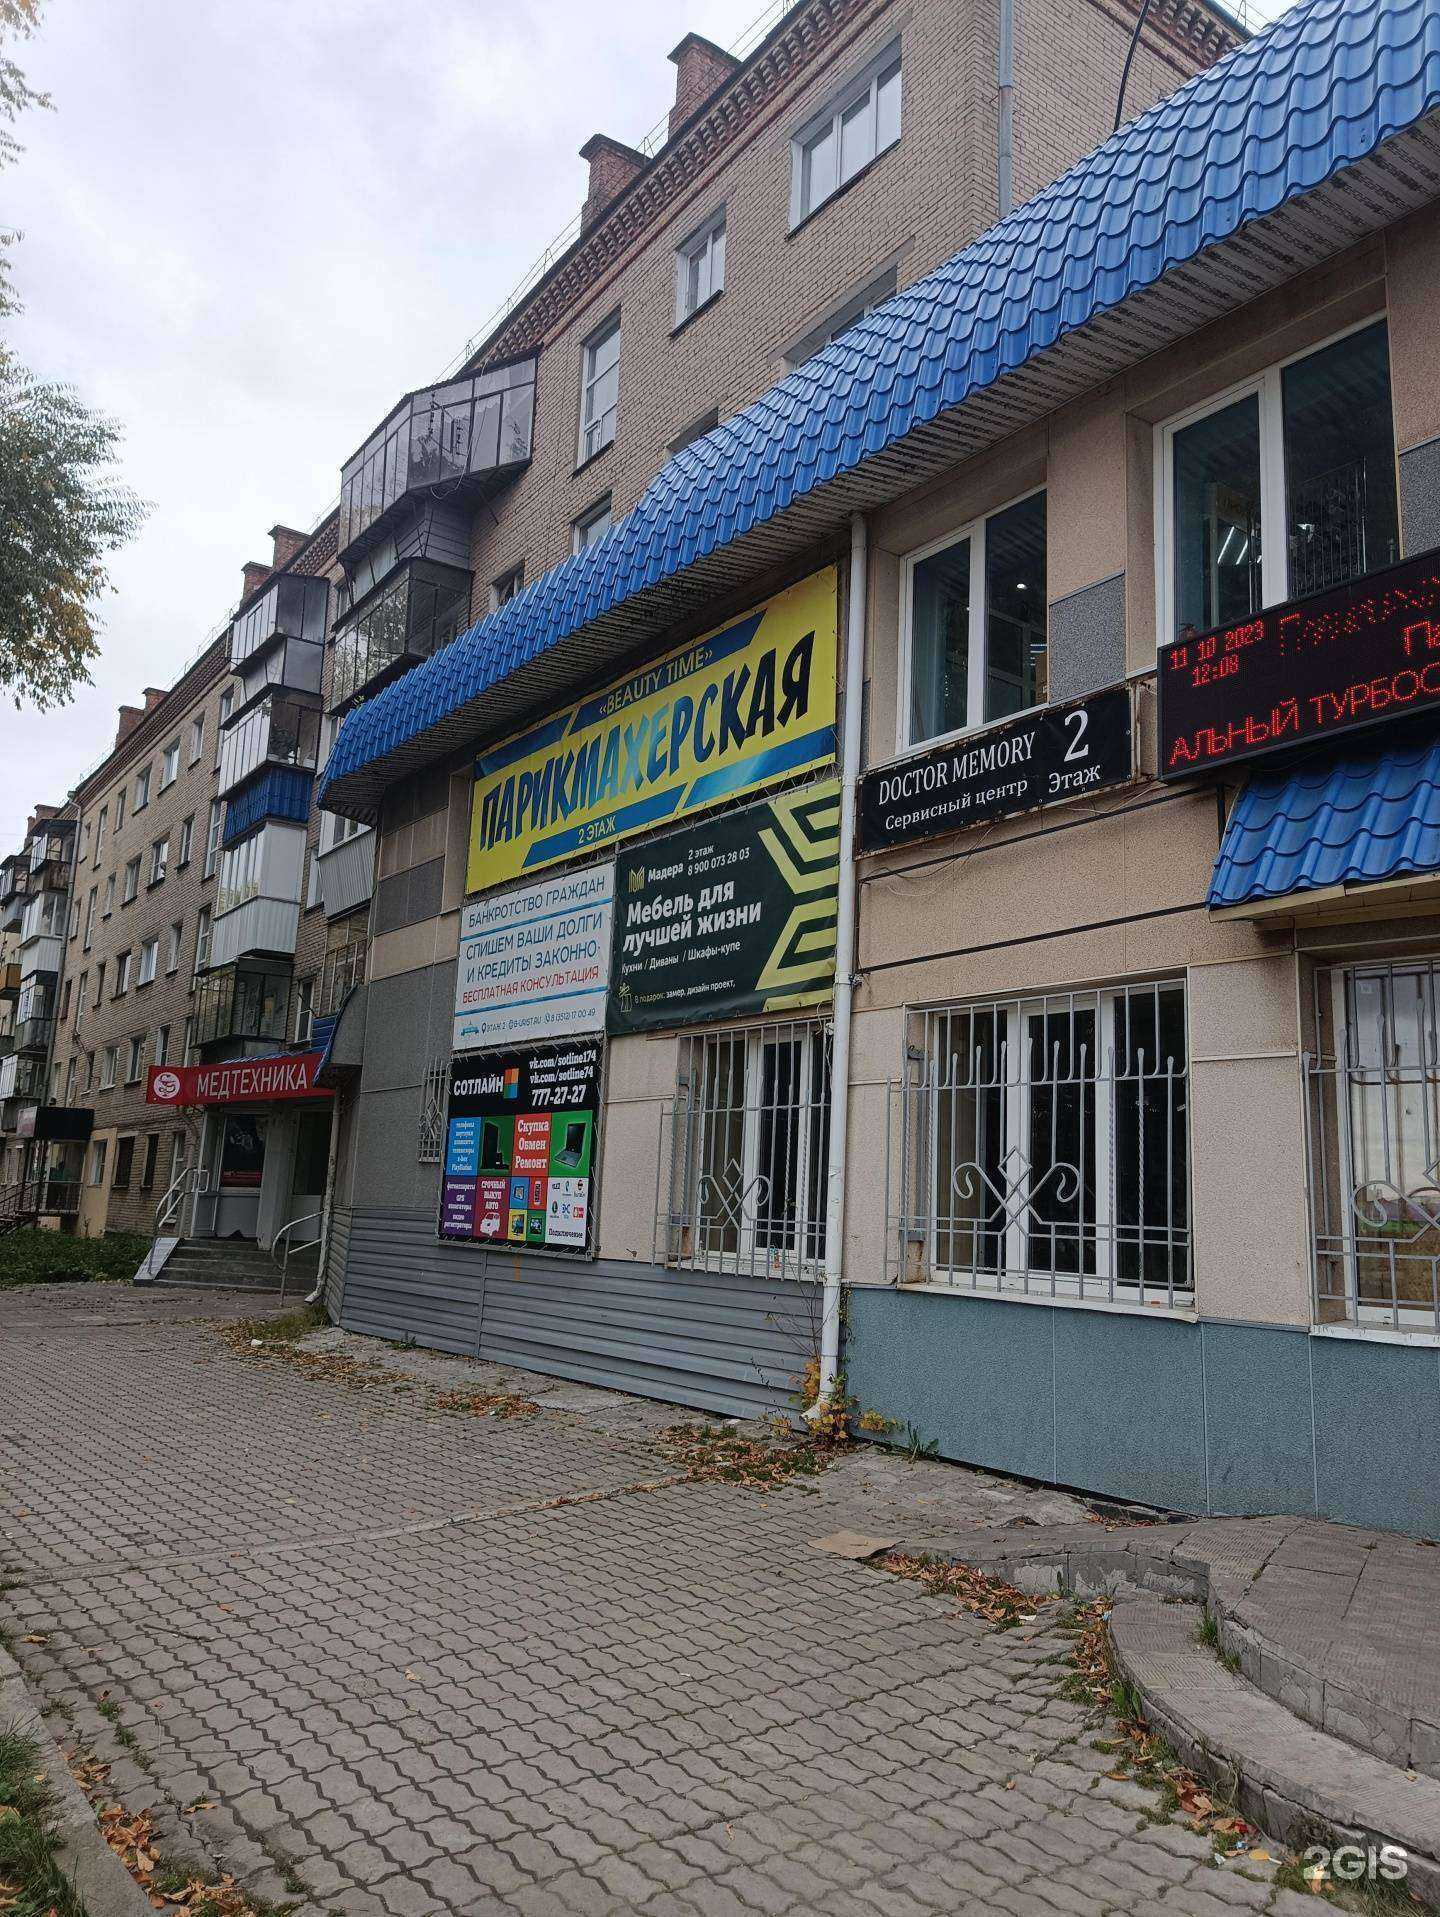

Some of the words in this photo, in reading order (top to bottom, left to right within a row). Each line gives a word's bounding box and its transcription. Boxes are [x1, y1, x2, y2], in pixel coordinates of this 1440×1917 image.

[600, 668, 662, 715] «BEAUTY
[666, 647, 713, 684] TIME»
[479, 630, 816, 852] ПАРИКМАХЕРСКАЯ
[1169, 697, 1300, 766] АЛЬНЫЙ
[878, 762, 948, 806] DOCTOR
[952, 731, 1036, 783] MEMORY
[1063, 709, 1090, 763] 2
[885, 793, 971, 830] Сервисный
[975, 780, 1028, 805] центр
[1048, 764, 1101, 794] Этаж
[578, 829, 585, 844] 2
[585, 815, 616, 842] ЭТАЖ
[687, 865, 693, 876] 8
[694, 859, 709, 874] 900
[711, 854, 726, 869] 073
[739, 846, 750, 860] 03
[688, 849, 694, 860] 2
[695, 845, 714, 859] этаж
[648, 862, 684, 882] Мадера
[469, 894, 542, 928] БАНКРОТСТВО
[546, 876, 605, 906] ГРАЖДАН
[626, 894, 693, 927] Мебель
[698, 881, 735, 913] для
[466, 935, 514, 960] СПИШЕМ
[517, 924, 553, 948] ВАШИ
[557, 912, 602, 941] ДОЛГИ
[623, 918, 693, 956] лучшей
[697, 901, 762, 935] жизни
[467, 968, 475, 983] И
[478, 954, 531, 980] КРЕДИТЫ
[649, 955, 679, 970] Диваны
[688, 941, 741, 960] Шкафы-купе
[463, 982, 519, 1004] БЕСПЛАТНАЯ
[520, 966, 599, 993] КОНСУЛЬТАЦИЯ
[687, 983, 710, 996] дизайн
[529, 1049, 597, 1069] vk.com/sotline174
[196, 1063, 308, 1100] МЕДТЕХНИКА
[453, 1074, 504, 1096] СОТЛАЙН
[530, 1066, 593, 1084] vk.com/sotline74
[532, 1085, 586, 1106] 777-27-27
[517, 1120, 549, 1135] Скупка
[515, 1156, 547, 1169] Ремонт
